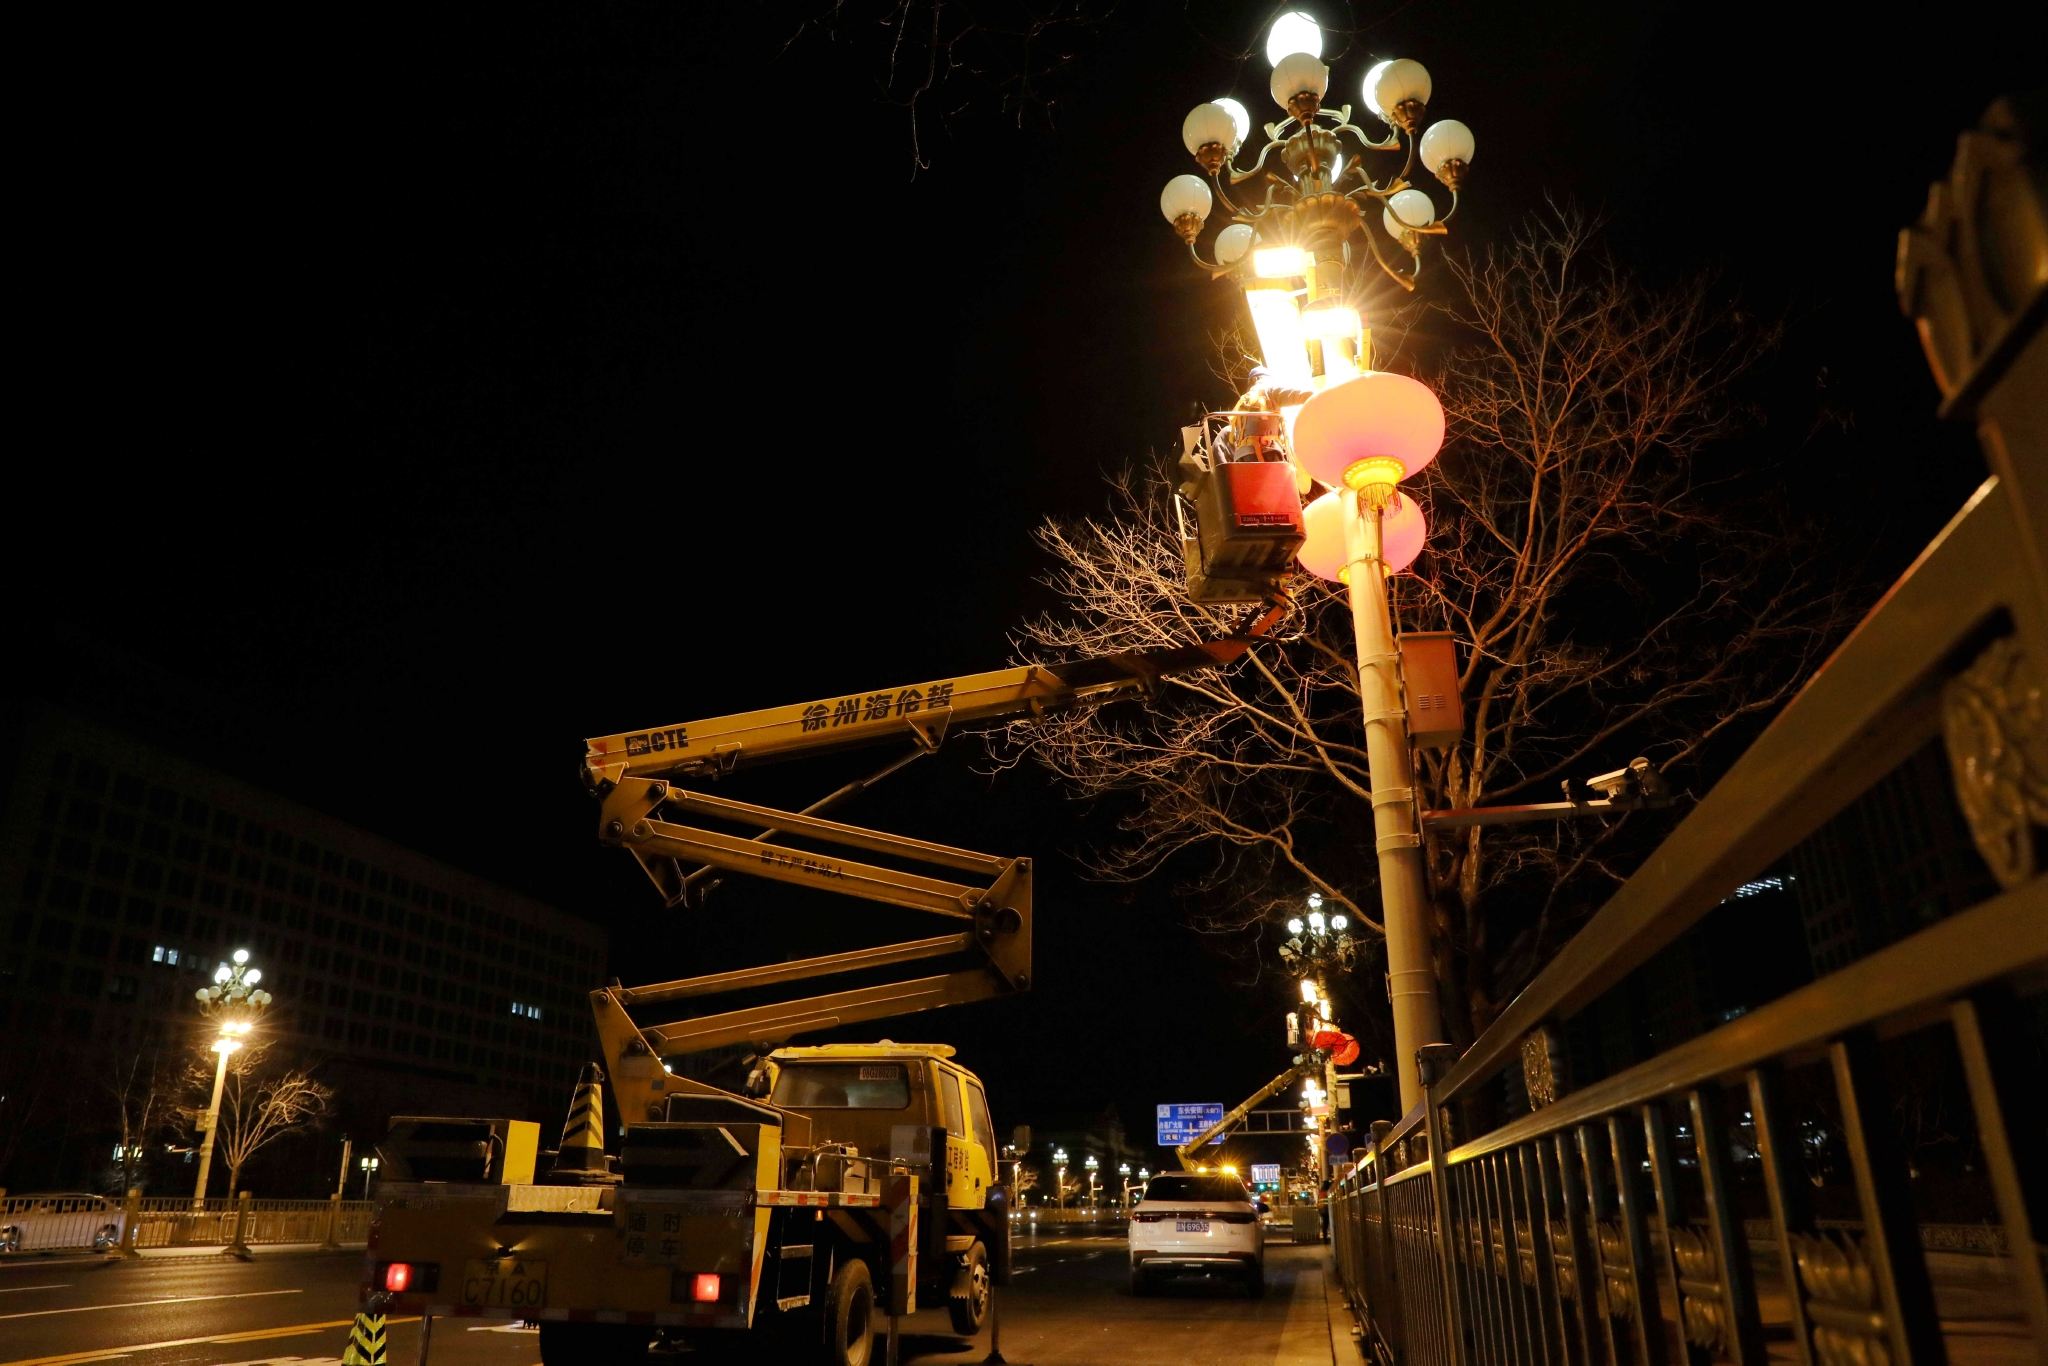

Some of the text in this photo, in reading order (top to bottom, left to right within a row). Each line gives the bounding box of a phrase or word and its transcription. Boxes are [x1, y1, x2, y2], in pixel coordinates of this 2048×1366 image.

[801, 683, 954, 732] 徐州海伦哲
[651, 727, 689, 752] CTE
[761, 850, 844, 880] 臂下严禁站人
[465, 1278, 541, 1305] C7160
